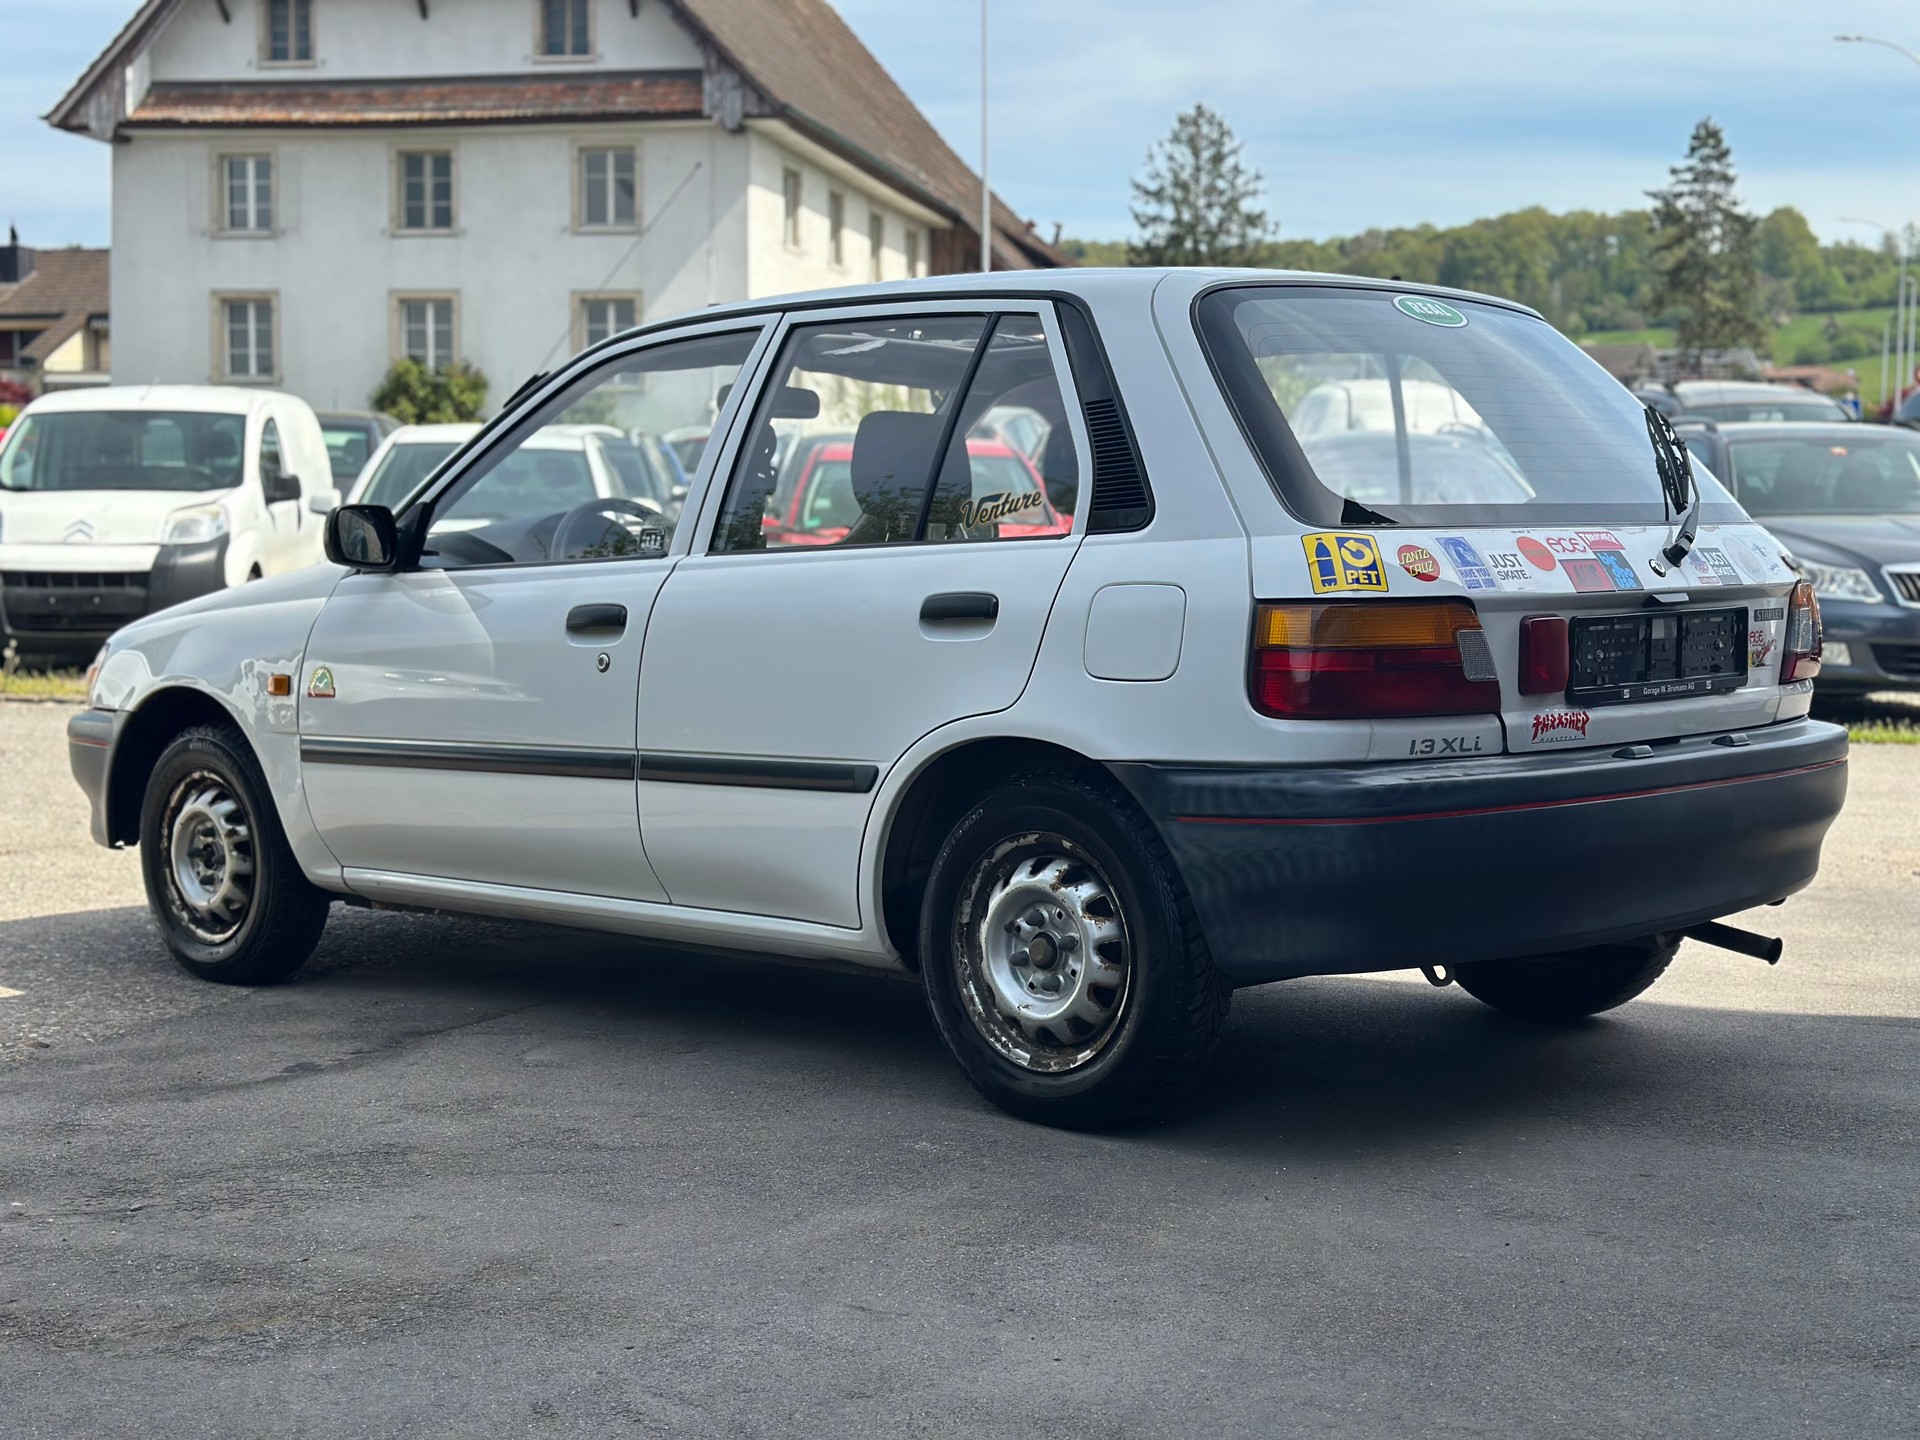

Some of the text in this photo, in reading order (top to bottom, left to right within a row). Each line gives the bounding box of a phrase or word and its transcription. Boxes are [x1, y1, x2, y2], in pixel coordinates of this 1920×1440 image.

[1405, 301, 1452, 317] REAL
[961, 491, 1042, 529] Venture
[1546, 537, 1587, 553] ACE
[1399, 549, 1430, 565] SANTA
[1488, 553, 1523, 569] JUST
[1702, 552, 1729, 566] JUST
[1409, 561, 1434, 577] CRUZ
[1458, 567, 1491, 579] HAVE YOU
[1713, 566, 1737, 576] SKATE
[1346, 570, 1378, 585] PET
[1465, 579, 1483, 589] SEEN
[1756, 610, 1783, 621] STARLET
[1643, 687, 1660, 695] Garage
[1667, 683, 1687, 693] Brumann
[1687, 682, 1695, 690] AG
[1531, 710, 1591, 742] THRASHER
[1409, 736, 1482, 756] 1.3 XLi
